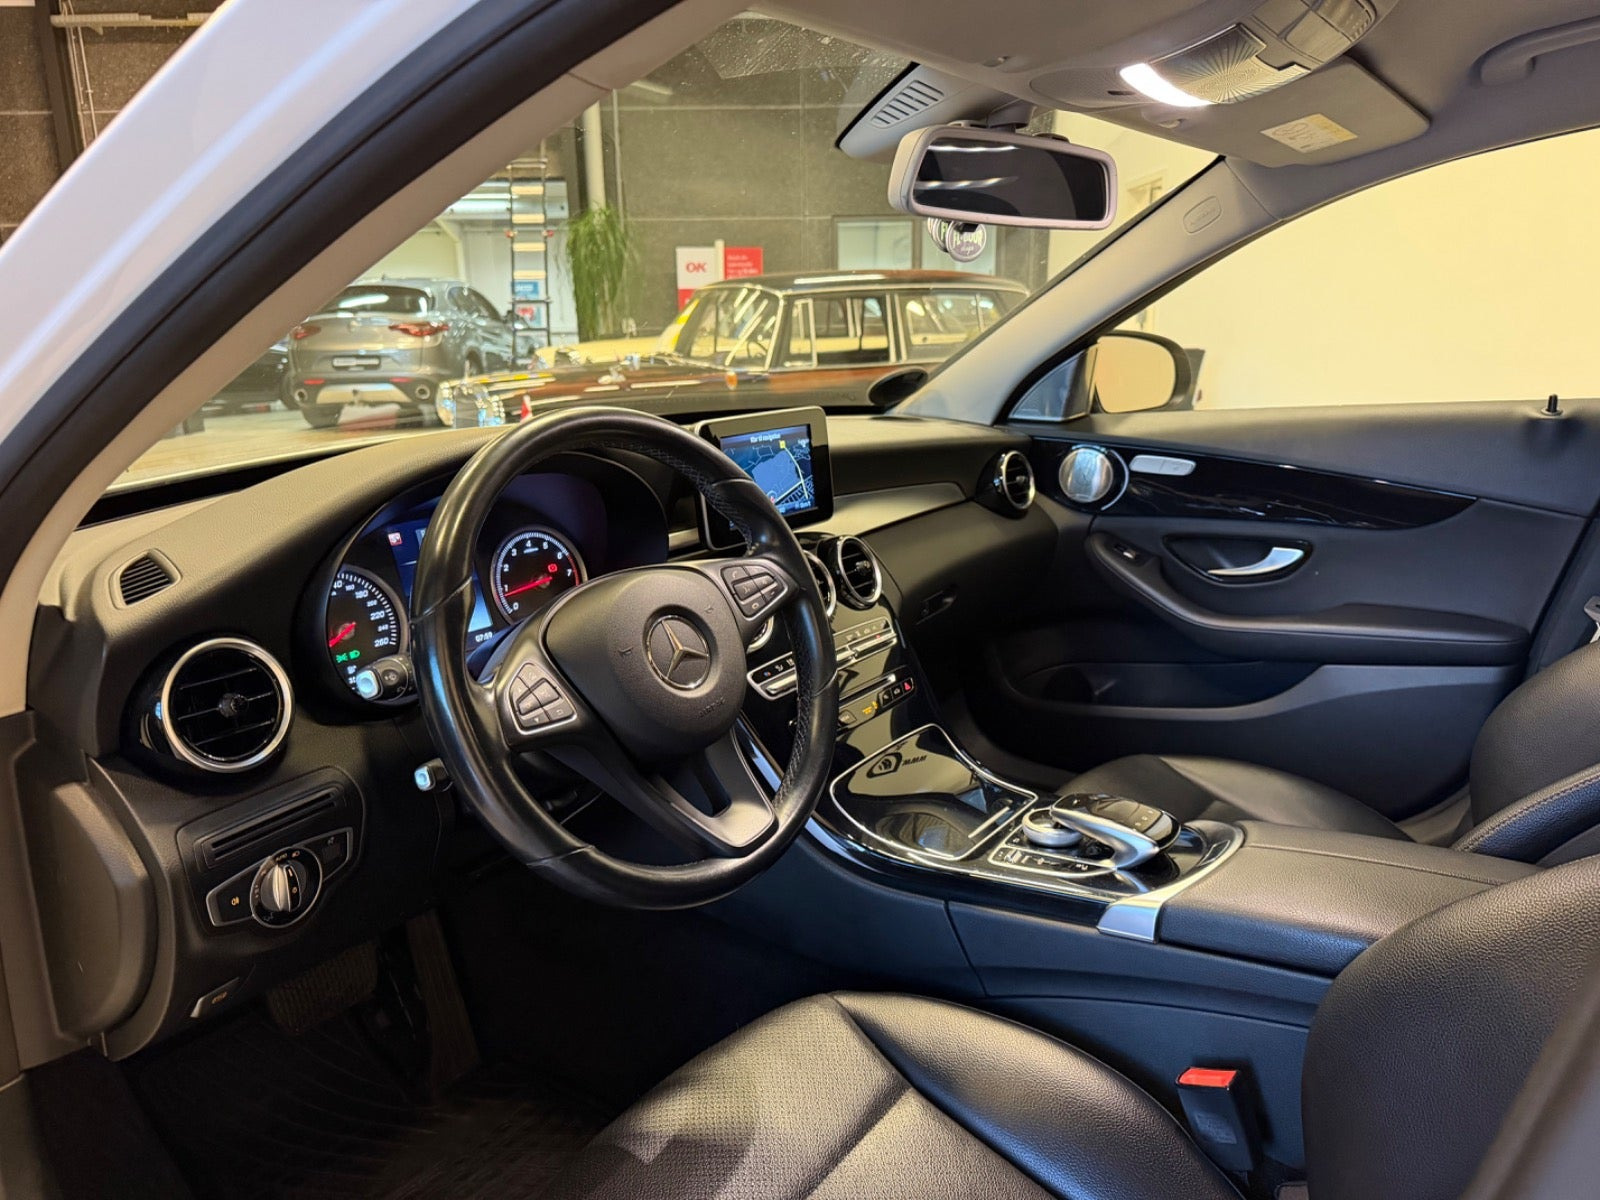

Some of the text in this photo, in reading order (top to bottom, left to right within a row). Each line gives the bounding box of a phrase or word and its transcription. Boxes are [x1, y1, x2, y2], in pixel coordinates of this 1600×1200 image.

[686, 262, 707, 273] OK
[542, 542, 548, 550] 5
[512, 548, 517, 556] 3
[513, 602, 519, 610] 0
[370, 610, 385, 621] 220
[374, 637, 389, 648] 260
